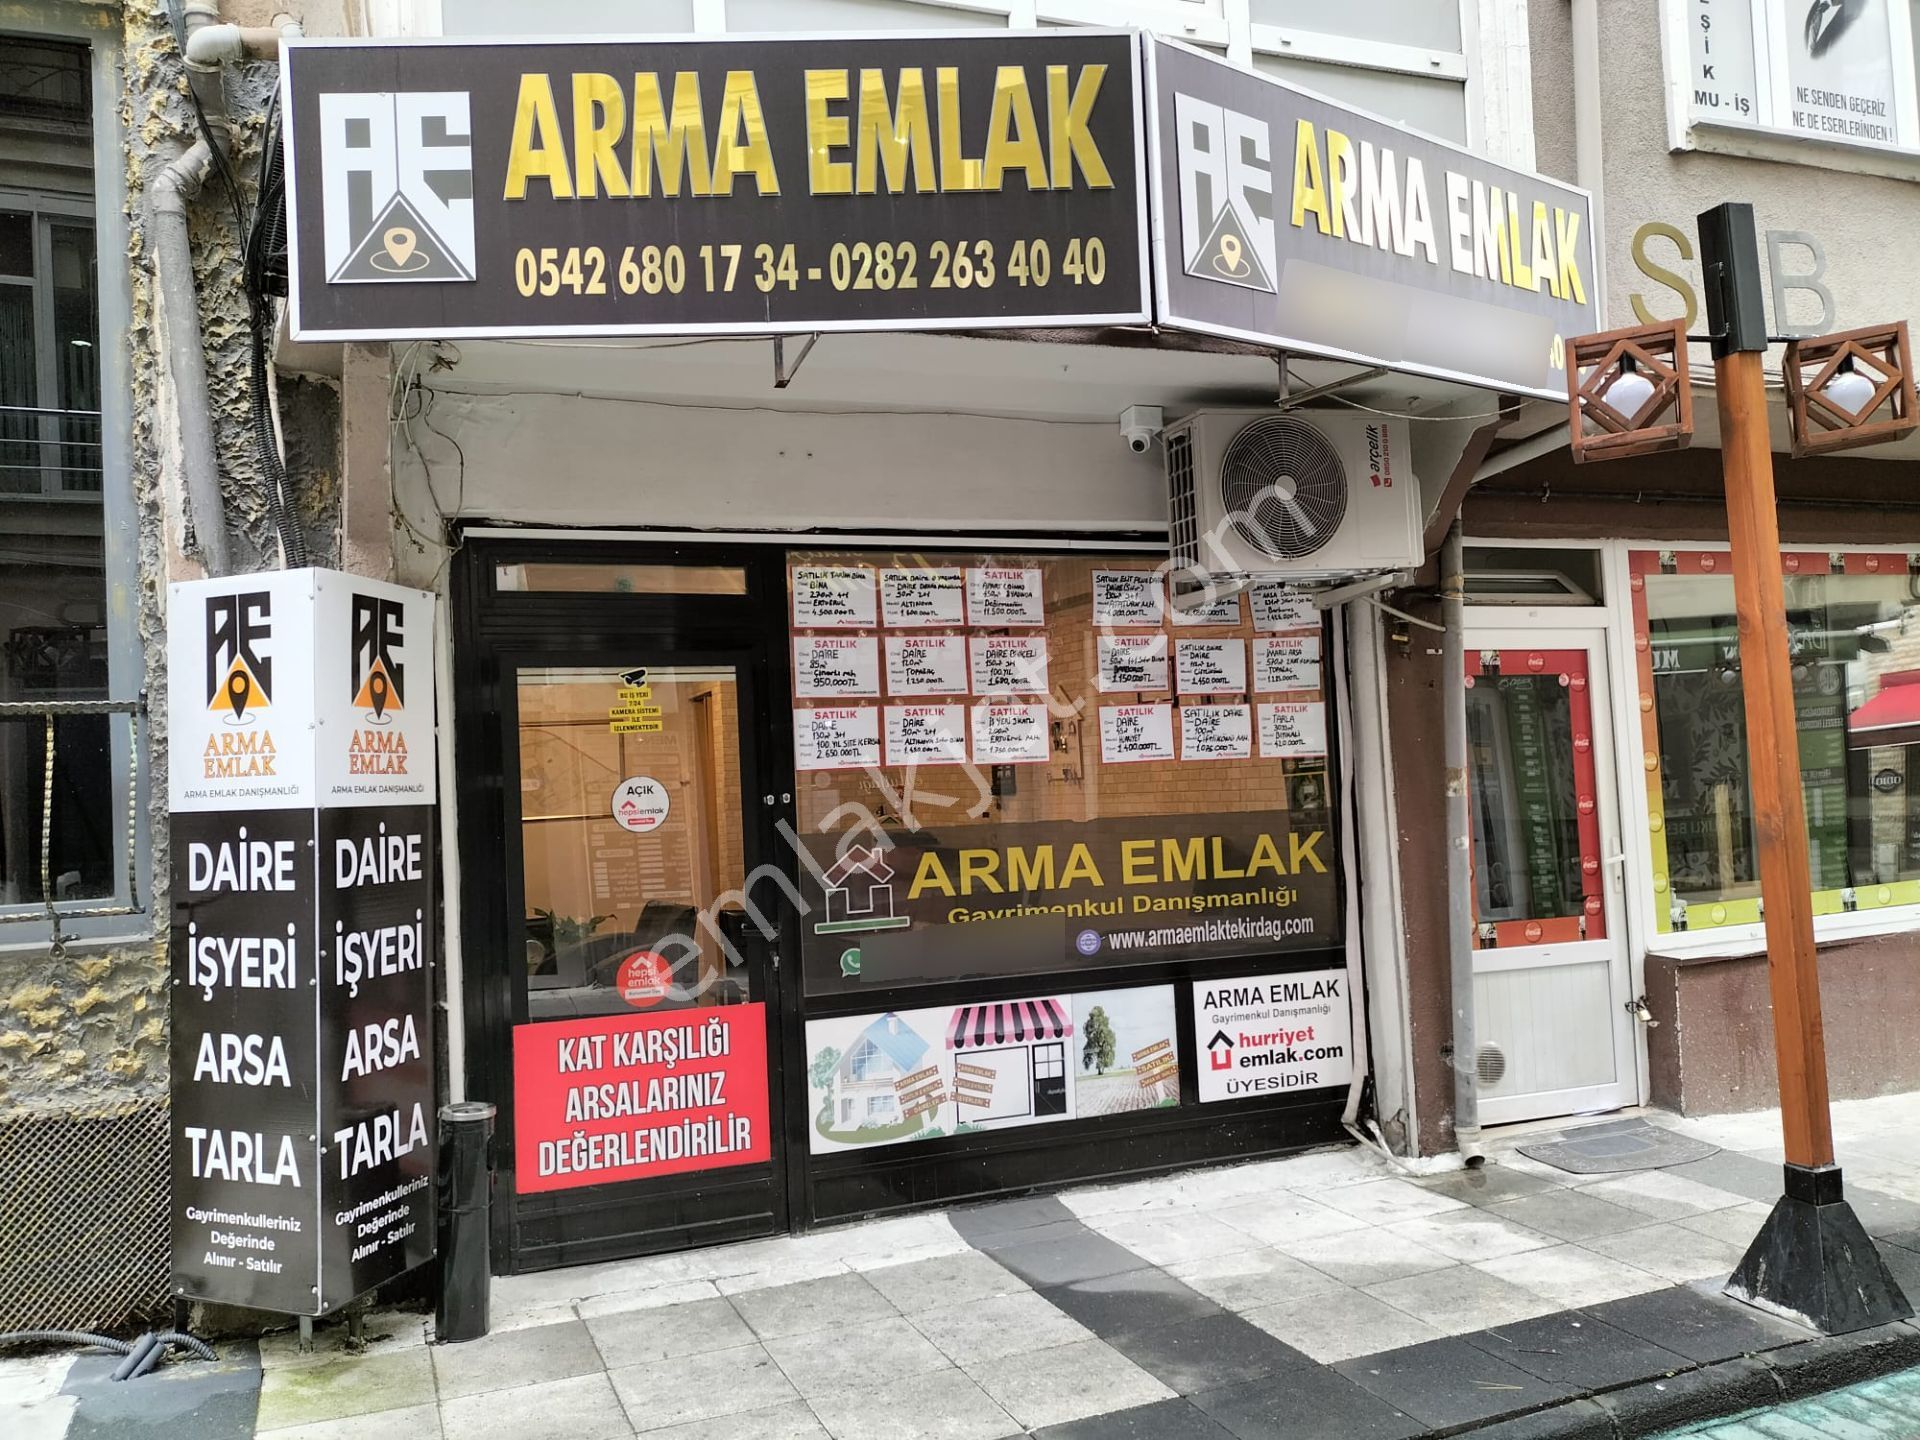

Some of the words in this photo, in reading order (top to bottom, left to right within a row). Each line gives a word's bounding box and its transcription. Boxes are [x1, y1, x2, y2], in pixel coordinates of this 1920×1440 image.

[1797, 86, 1809, 103] NE
[1811, 88, 1847, 110] SENDEN
[1849, 94, 1886, 118] GEÇERİZ
[503, 70, 780, 200] ARMA
[804, 64, 1116, 196] EMLAK
[1792, 110, 1806, 128] NE
[1807, 112, 1821, 130] DE
[1821, 114, 1888, 142] ESERLERİNDEN
[1291, 119, 1437, 265] ARMA
[1445, 171, 1586, 304] EMLAK
[516, 244, 606, 298] 0542
[618, 244, 686, 296] 680
[699, 244, 741, 293] 17
[930, 239, 996, 289] 263
[1008, 238, 1051, 287] 40
[1062, 237, 1106, 286] 40
[1366, 424, 1382, 472] arçelik
[985, 571, 1023, 580] SATILIK
[811, 649, 839, 660] DAİRE
[814, 640, 857, 648] SATILIK
[902, 648, 927, 659] DAİRE
[905, 639, 945, 648] SATILIK
[988, 640, 1027, 649] SATILIK
[1114, 638, 1150, 646] SATILIK
[1269, 640, 1303, 648] SATILIK
[814, 710, 857, 719] SATILIK
[904, 708, 945, 717] SATILIK
[990, 707, 1029, 716] SATILIK
[1117, 707, 1154, 716] SATILIK
[1274, 705, 1308, 713] SATILIK
[902, 717, 925, 728] DAİRE
[204, 730, 276, 757] ARMA
[348, 730, 408, 754] ARMA
[204, 755, 276, 779] EMLAK
[349, 754, 408, 775] EMLAK
[184, 788, 208, 799] ARMA
[210, 788, 237, 798] EMLAK
[239, 785, 299, 798] DANIŞMANLIĞI
[332, 785, 352, 794] ARMA
[354, 784, 377, 793] EMLAK
[378, 784, 424, 795] DANIŞMANLIĞI
[627, 785, 654, 797] AÇIK
[188, 826, 296, 893] DAİRE
[335, 822, 422, 889] DAİRE
[907, 843, 1103, 900] ARMA
[1122, 830, 1328, 885] EMLAK
[1133, 887, 1298, 915] Danışmanlığı
[1108, 914, 1314, 951] www.armaemlaktekirdag.com
[188, 921, 296, 1001] İŞYERİ
[335, 908, 423, 998] İŞYERİ
[1203, 987, 1265, 1011] ARMA
[1270, 979, 1340, 1004] EMLAK
[1211, 1009, 1270, 1026] Gayrimenkul
[1273, 1004, 1331, 1019] Danışmanlığı
[341, 1013, 421, 1082] ARSA
[558, 1035, 607, 1073] KAT
[613, 1016, 730, 1069] KARŞILIĞI
[1239, 1026, 1315, 1049] hurriyet
[194, 1032, 292, 1088] ARSA
[1239, 1045, 1343, 1069] emlak.com
[1226, 1070, 1319, 1095] ÜYESİDİR
[565, 1071, 726, 1123] ARSALARINIZ
[334, 1102, 428, 1180] TARLA
[538, 1113, 751, 1177] DEĞERLENDİRİLİR
[185, 1127, 302, 1188] TARLA
[335, 1175, 429, 1227] Gayrimenkulleriniz
[186, 1206, 301, 1233] Gayrimenkulleriniz
[357, 1203, 410, 1240] Değerinde
[211, 1231, 275, 1252] Değerinde
[351, 1236, 379, 1264] Alınır
[387, 1220, 416, 1248] Satılır
[204, 1251, 235, 1270] Alınır
[246, 1256, 283, 1275] Satılır
